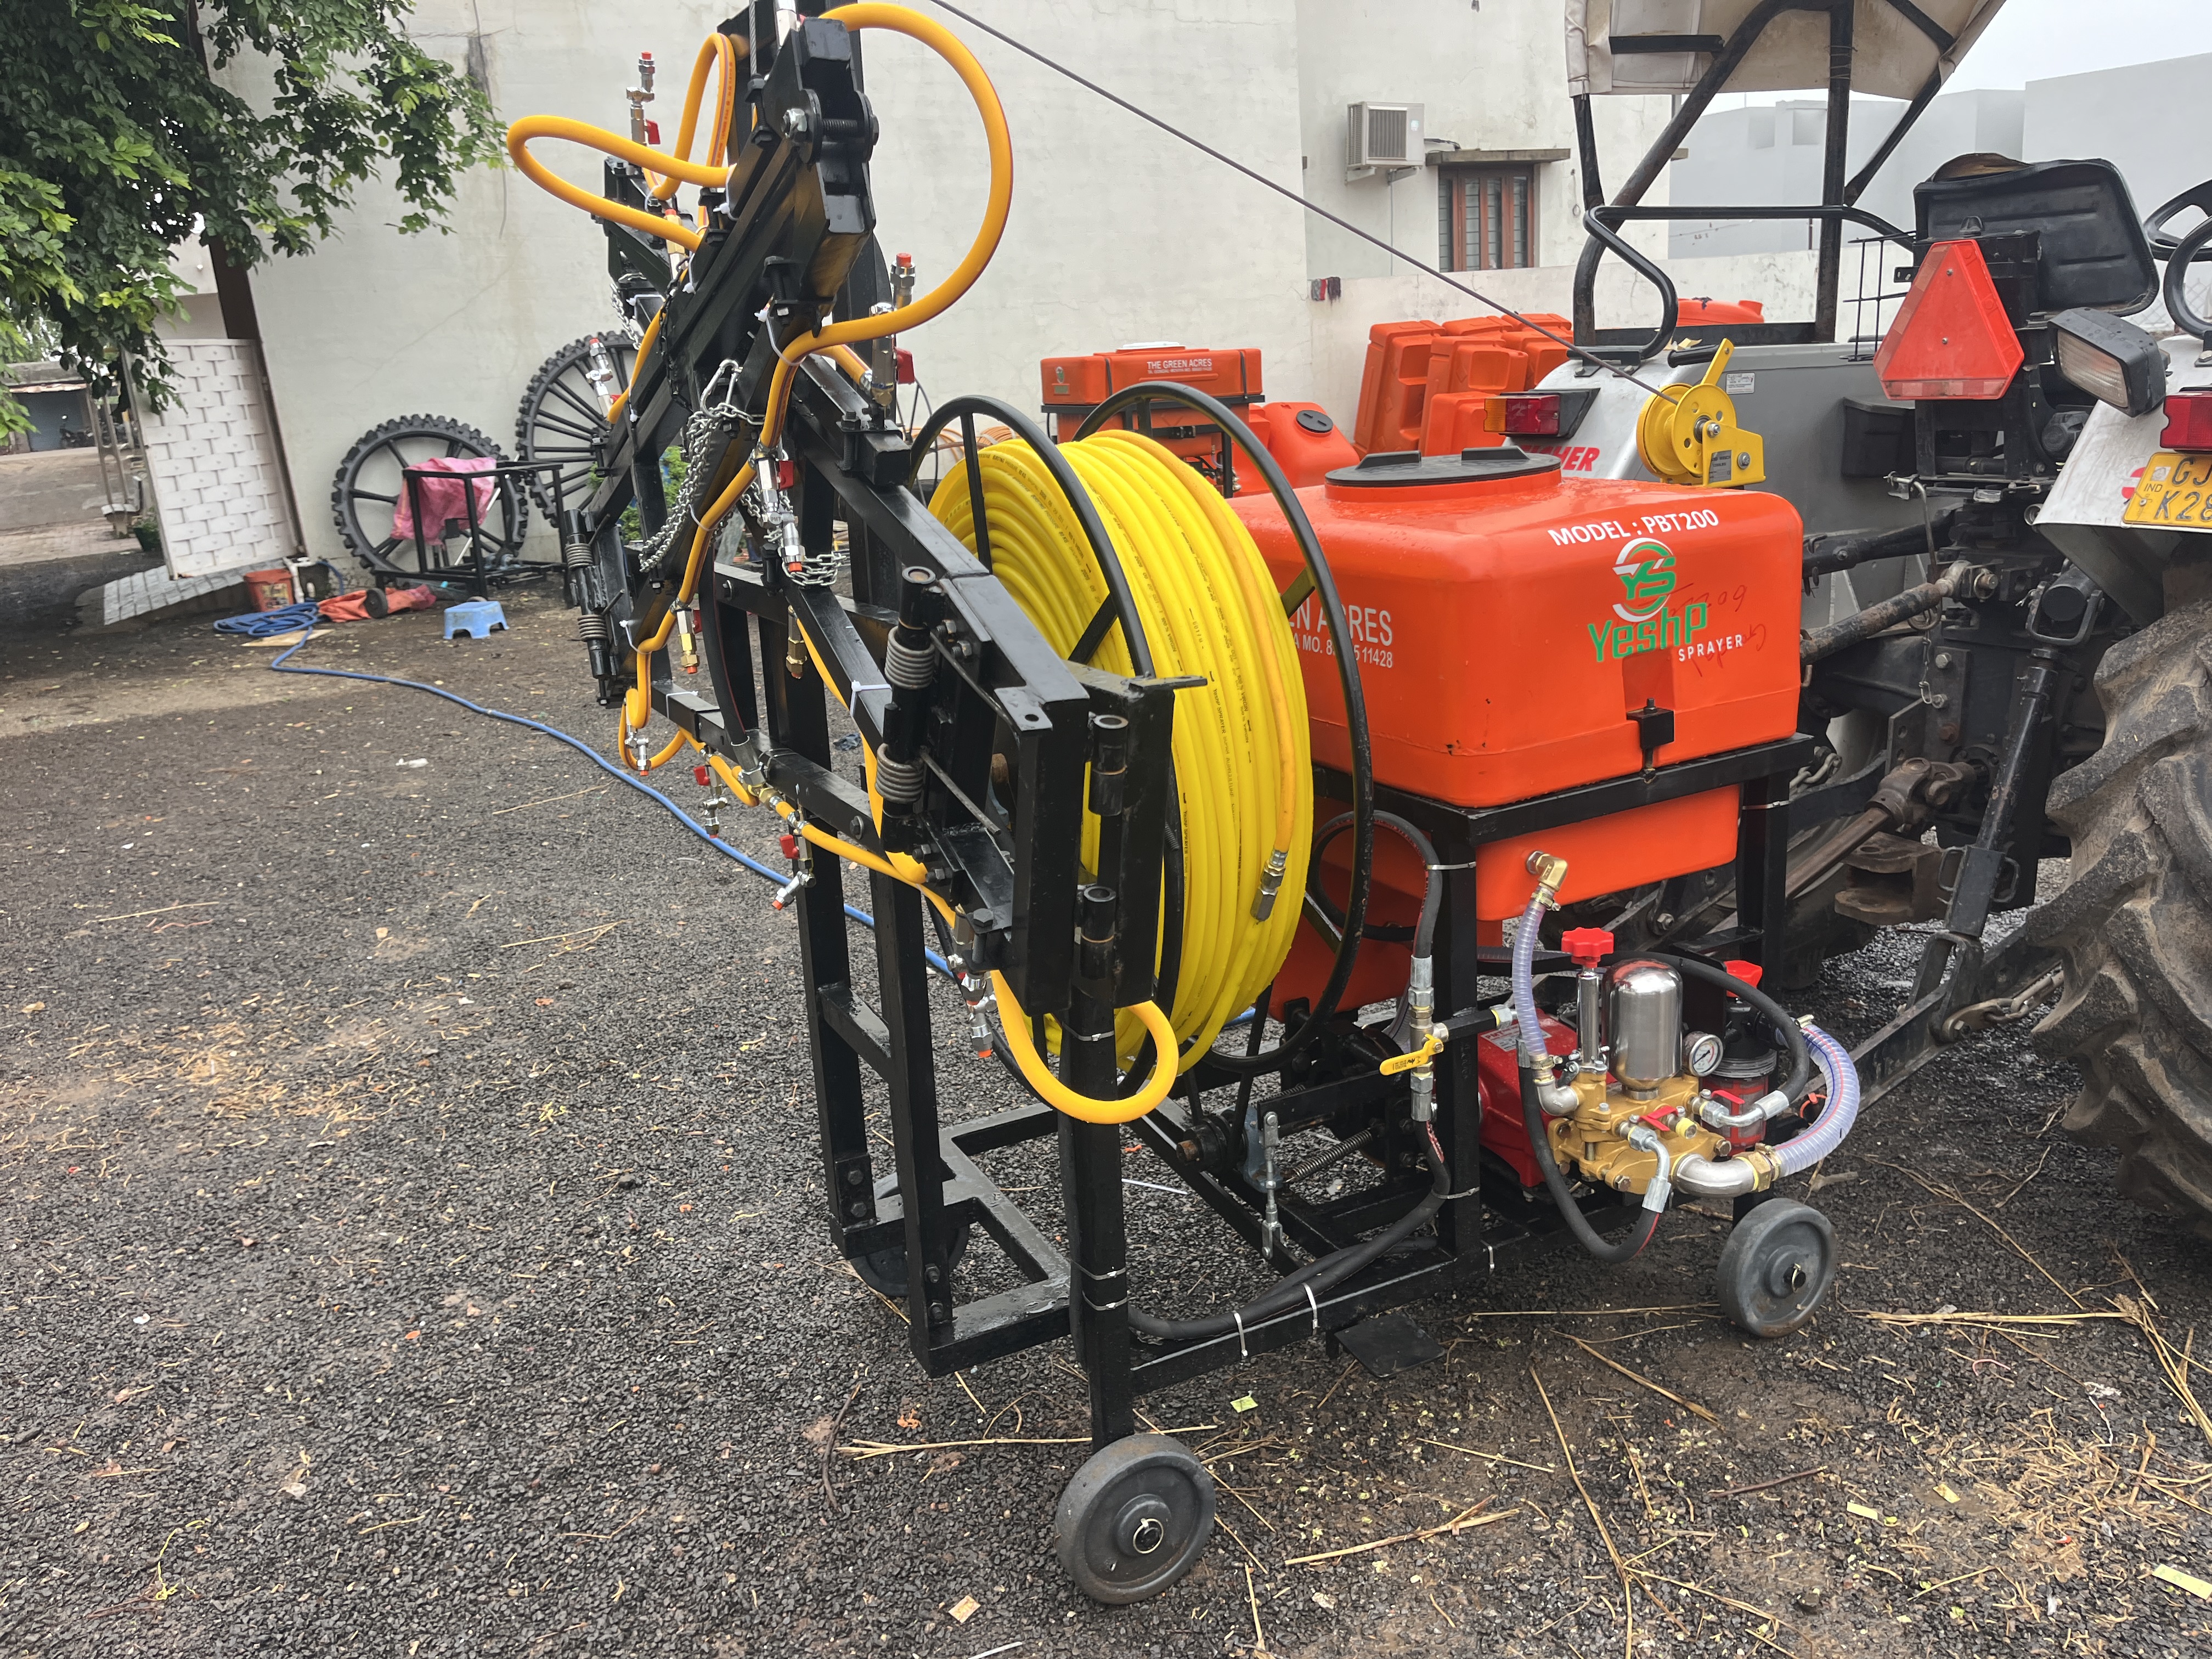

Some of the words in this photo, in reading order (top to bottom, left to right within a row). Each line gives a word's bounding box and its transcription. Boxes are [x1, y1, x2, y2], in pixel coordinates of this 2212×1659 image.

[1147, 360, 1161, 369] THE
[1163, 359, 1188, 369] GREEN
[1188, 358, 1212, 368] ACRES
[2143, 483, 2163, 493] IND
[1548, 521, 1631, 546] MODEL
[1640, 509, 1719, 534] PBT200
[1678, 634, 1743, 662] SPRAYER
[1216, 706, 1227, 734] SPRAYER
